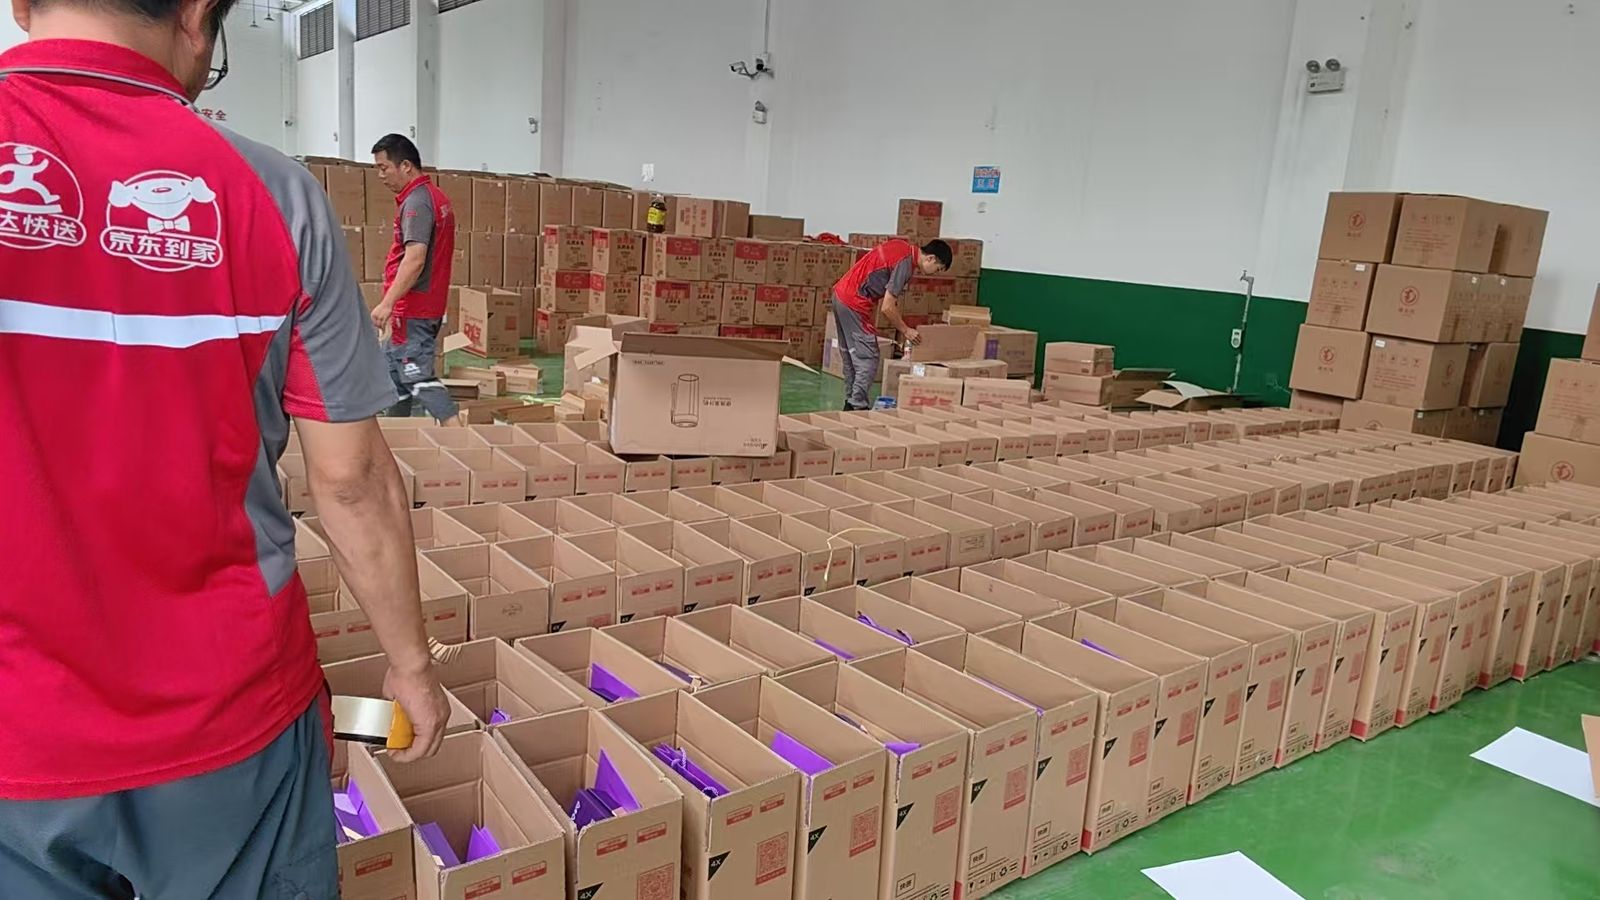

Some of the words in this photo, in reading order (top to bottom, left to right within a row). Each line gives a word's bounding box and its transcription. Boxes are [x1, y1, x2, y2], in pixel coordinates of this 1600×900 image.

[201, 109, 227, 121] 安全
[109, 231, 217, 262] 京东到家
[899, 809, 907, 817] 4X
[810, 832, 819, 841] 4X
[711, 858, 721, 867] 4X
[580, 890, 592, 900] 4X
